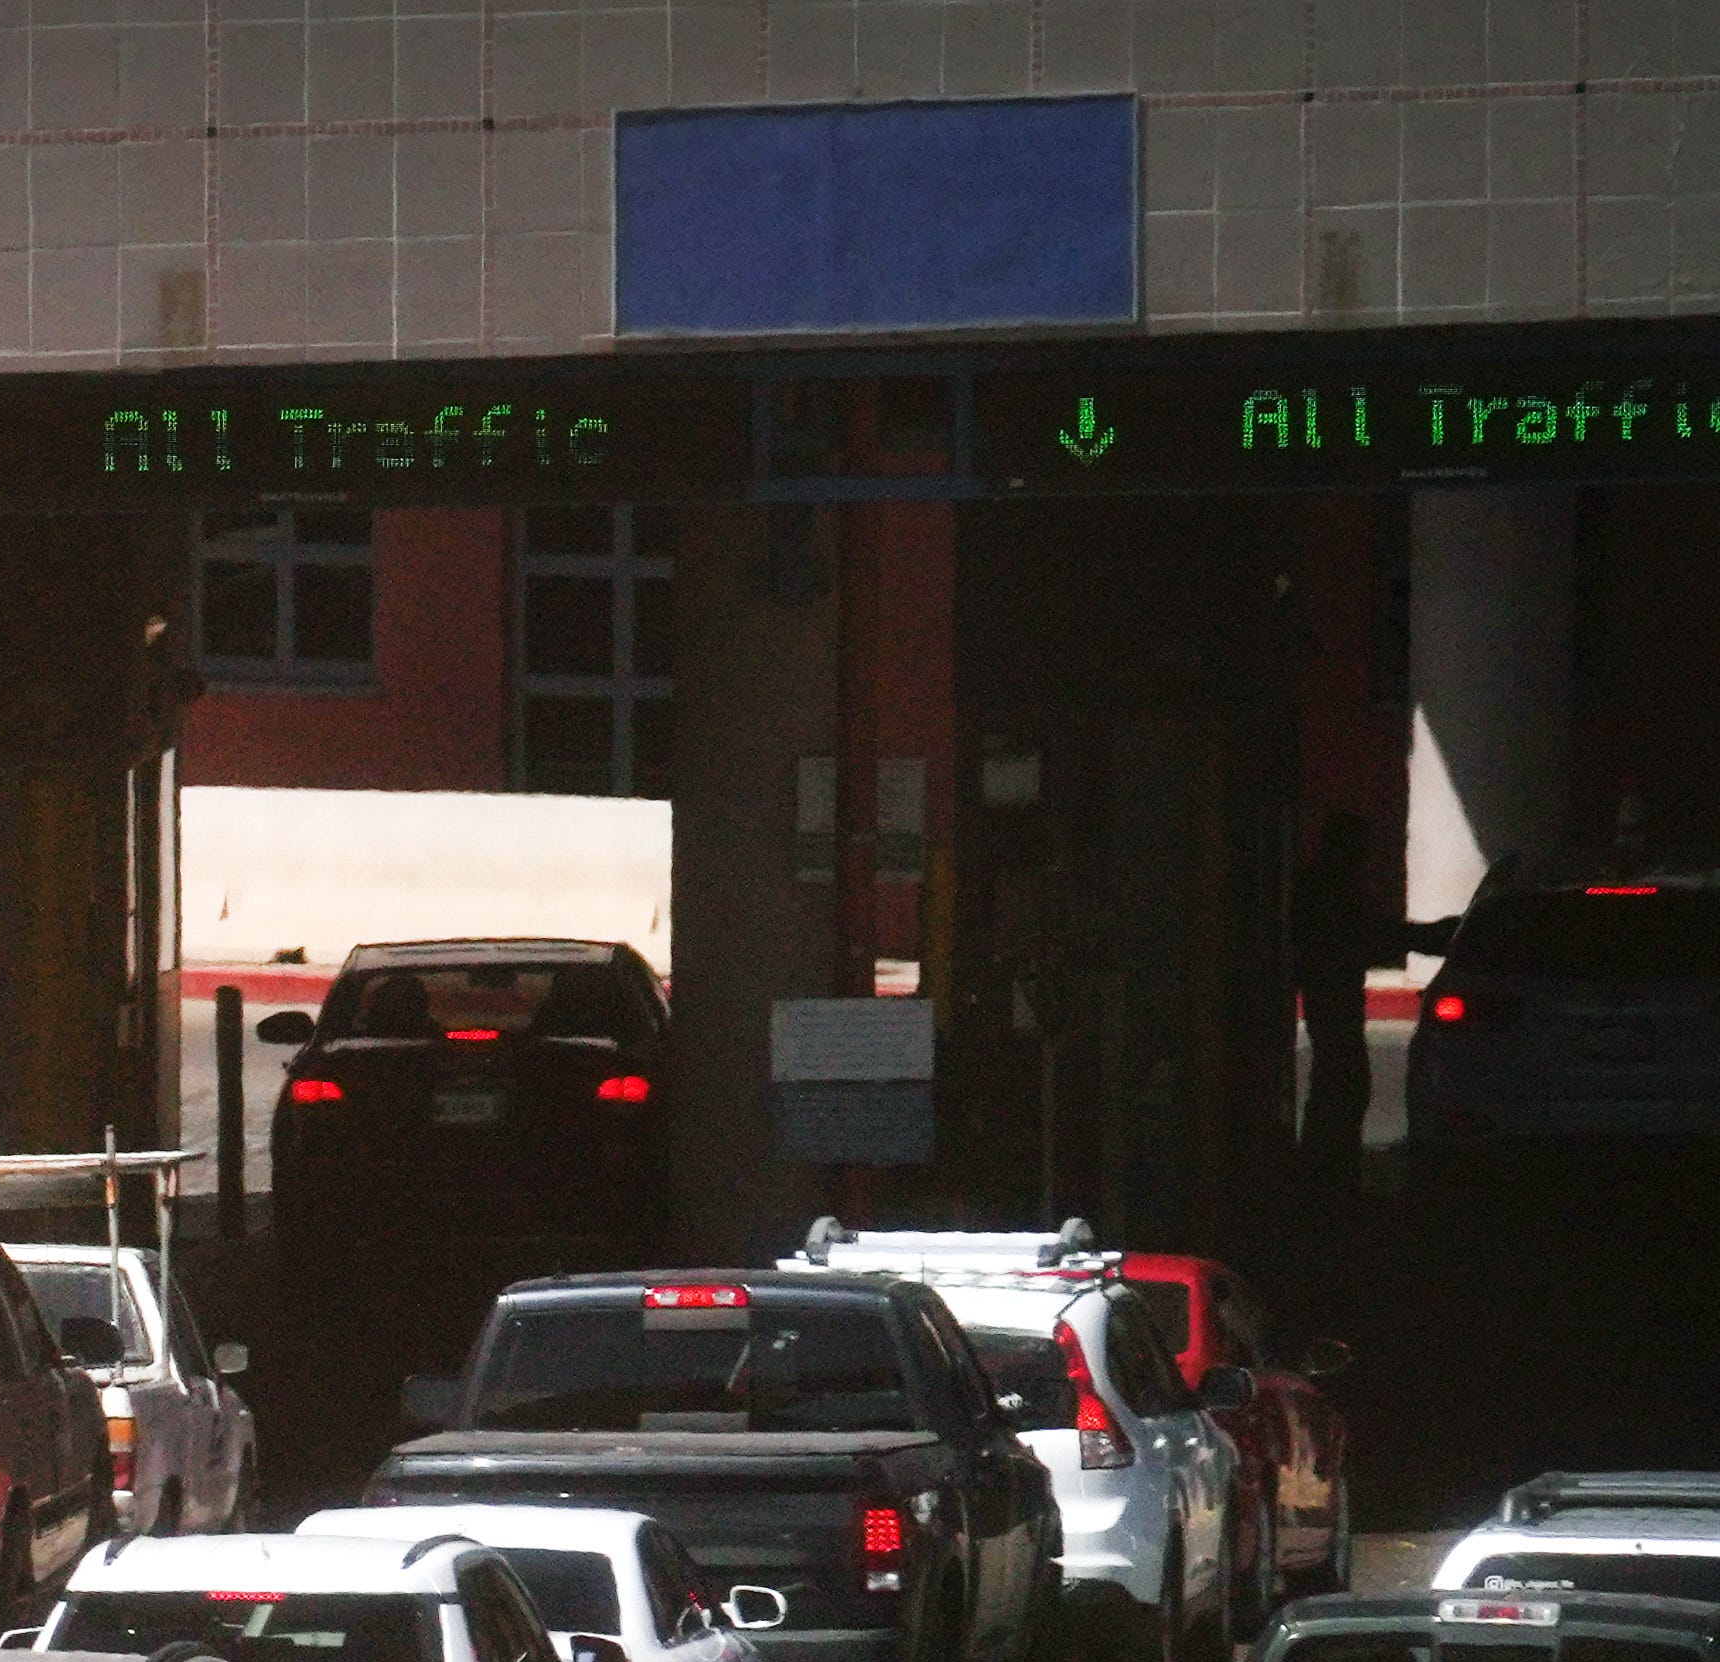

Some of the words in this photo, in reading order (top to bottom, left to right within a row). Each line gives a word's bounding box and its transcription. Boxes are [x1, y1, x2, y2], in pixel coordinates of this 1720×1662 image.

[104, 408, 232, 472] All
[278, 404, 609, 469] Traffic
[1243, 384, 1371, 450] All
[1417, 377, 1720, 446] Traffi
